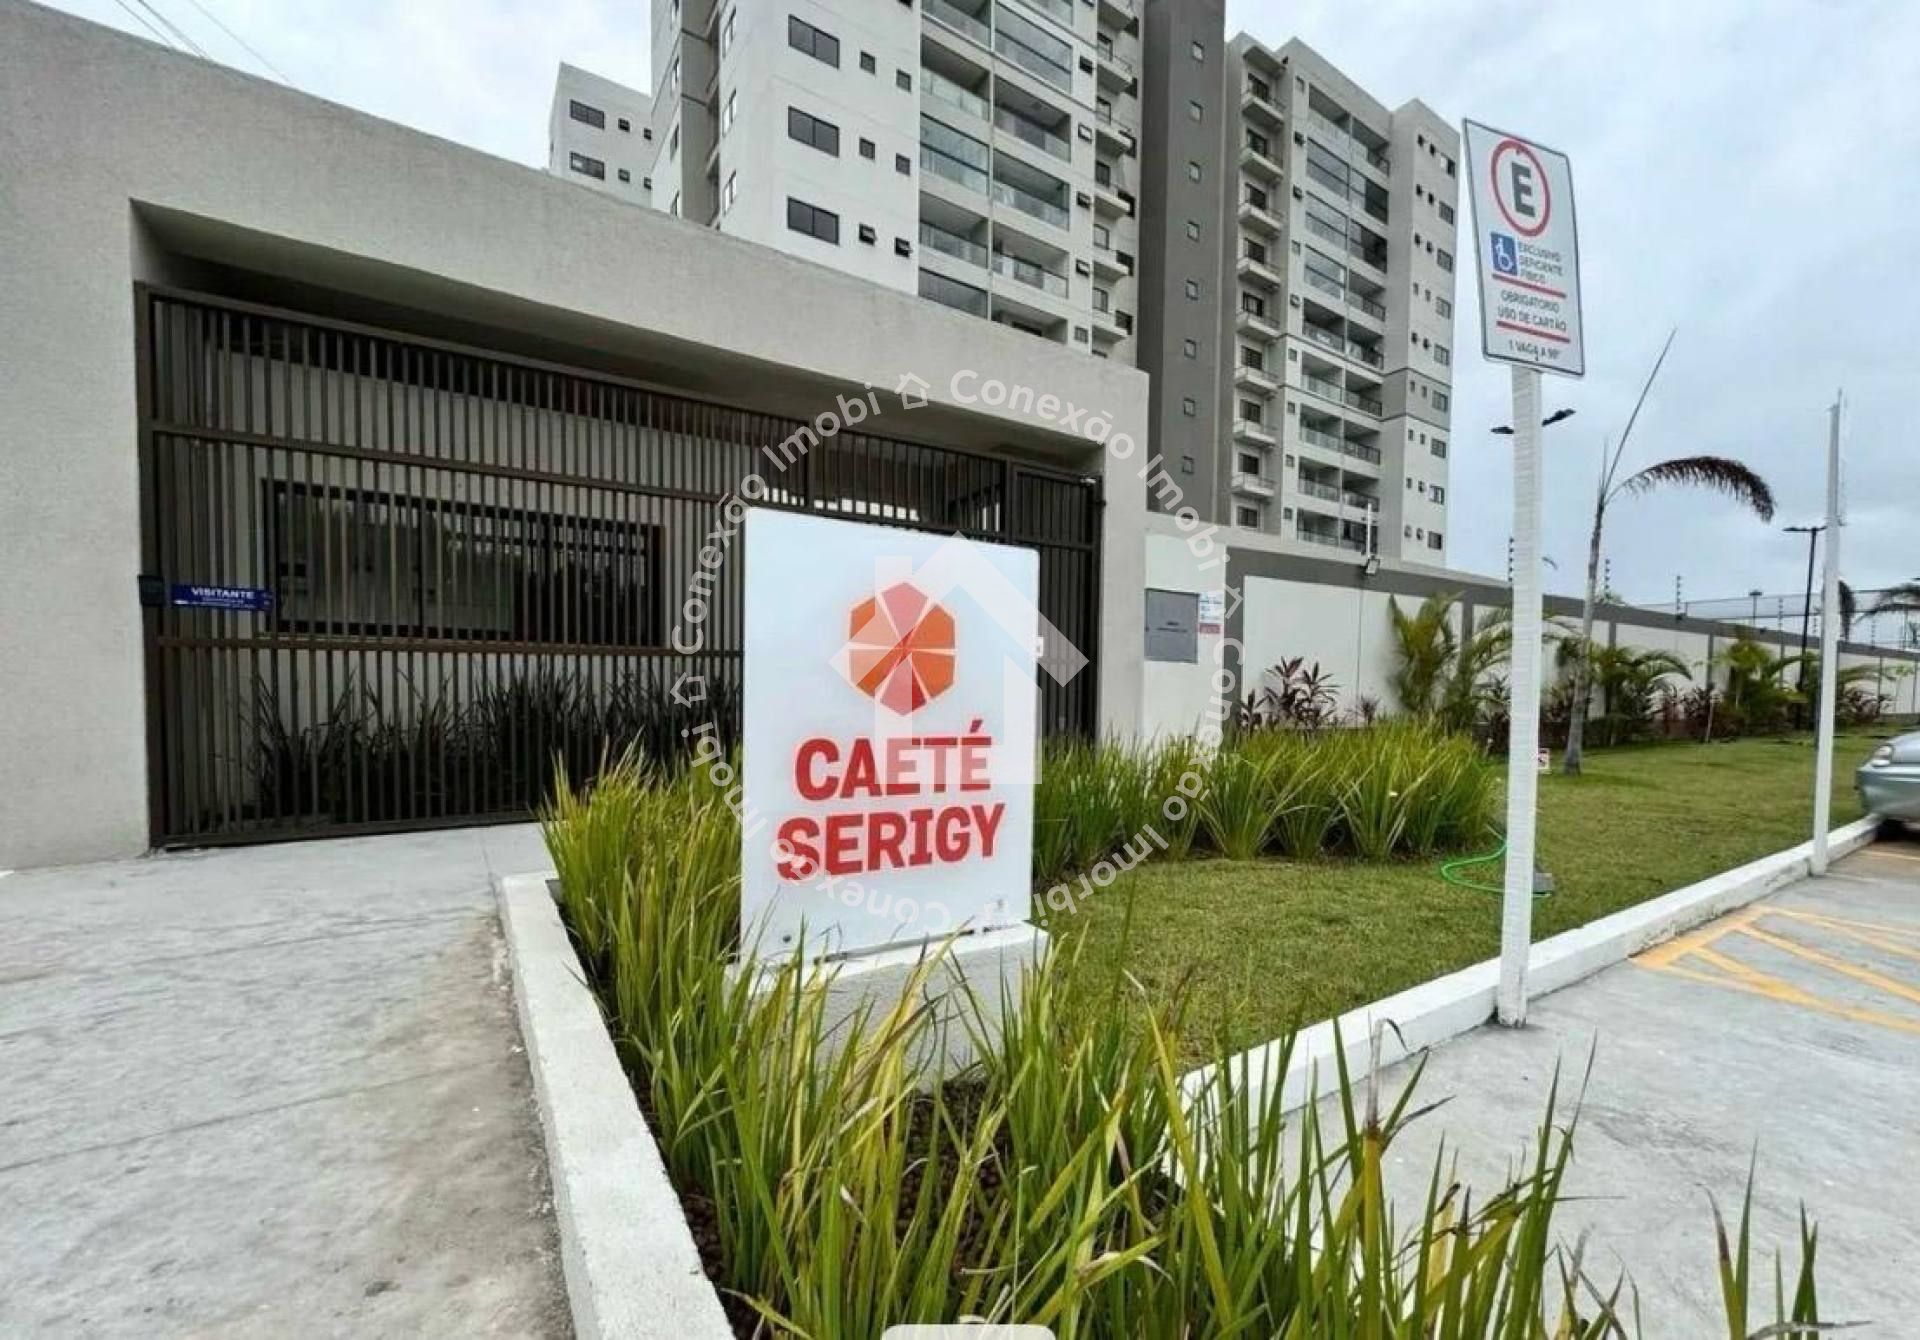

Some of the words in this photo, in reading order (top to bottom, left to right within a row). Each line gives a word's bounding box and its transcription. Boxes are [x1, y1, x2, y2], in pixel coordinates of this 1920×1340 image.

[1511, 162, 1535, 217] E
[1519, 311, 1531, 324] DE
[191, 587, 255, 599] VISITANTE
[794, 719, 992, 802] CAETÉ
[776, 803, 1006, 881] SERIGY
